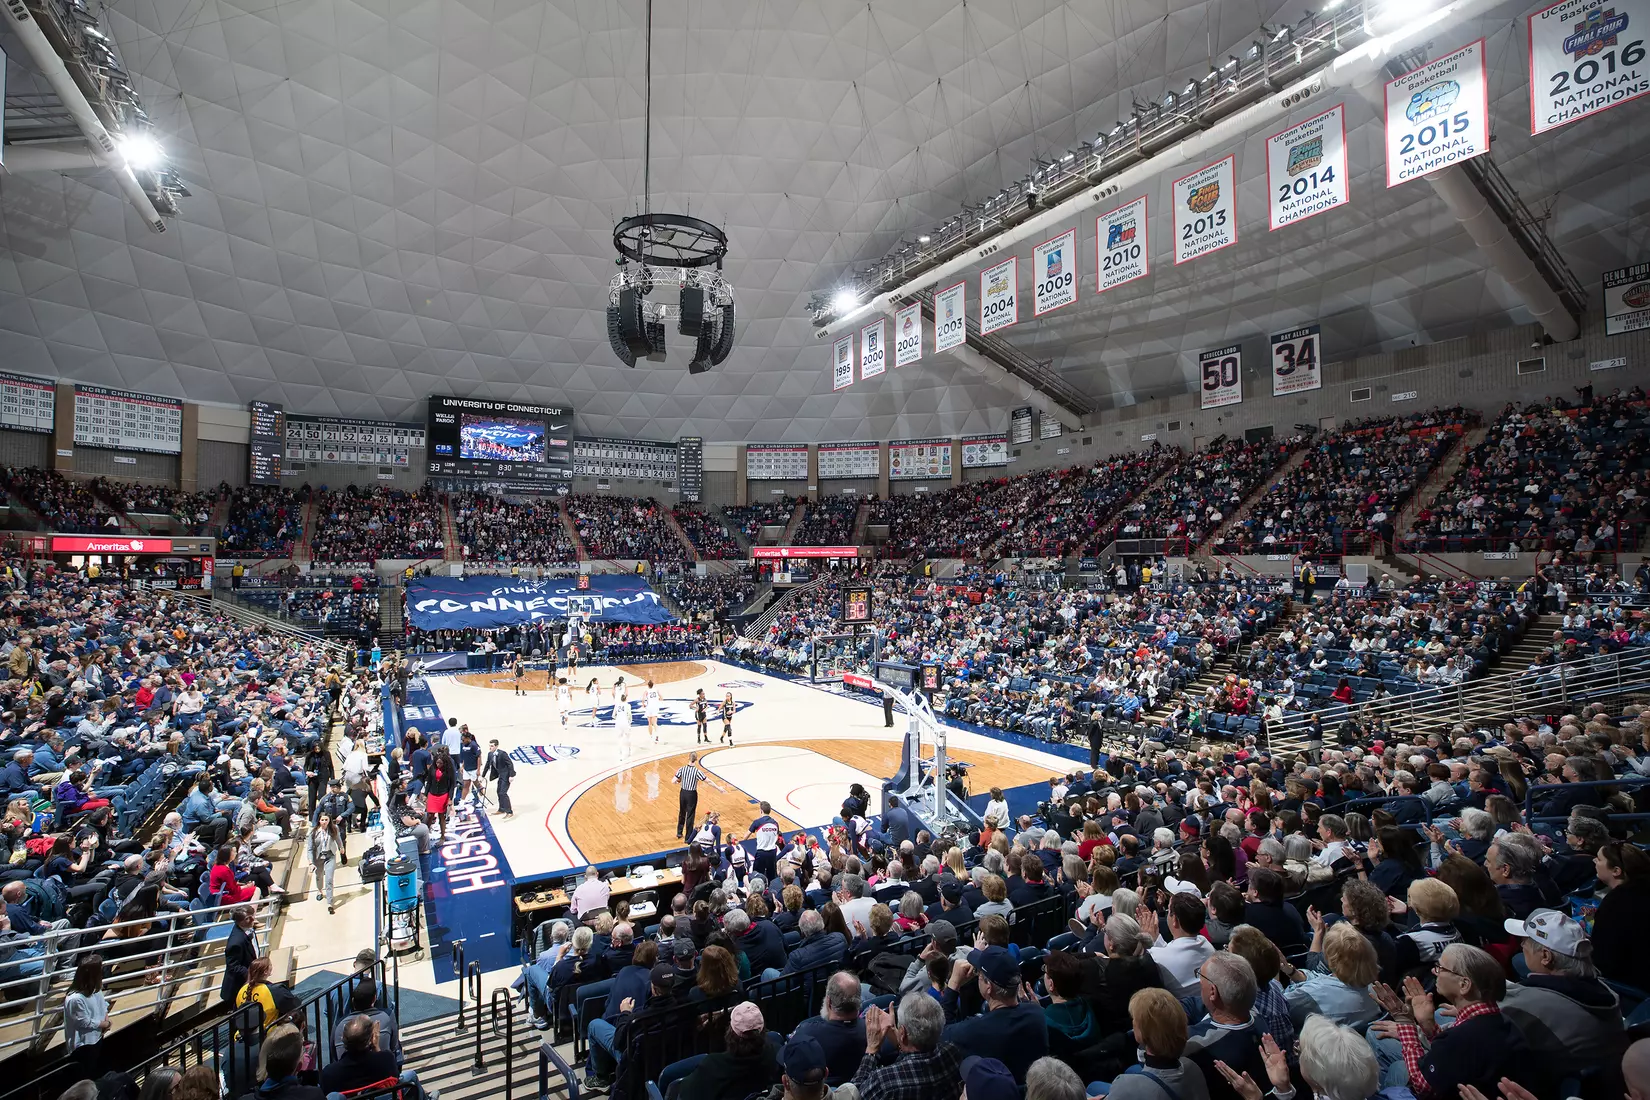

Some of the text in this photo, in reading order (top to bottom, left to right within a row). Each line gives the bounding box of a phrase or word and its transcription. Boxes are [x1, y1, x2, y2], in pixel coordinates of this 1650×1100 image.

[1542, 0, 1582, 19] UCon
[1561, 0, 1608, 22] Basket
[1568, 18, 1623, 50] FINAL FOUR
[1394, 47, 1473, 88] UConn Women's
[1550, 40, 1646, 97] 2016
[1408, 63, 1458, 91] Basketball
[1554, 70, 1641, 109] NATIONAL
[1548, 80, 1650, 124] CHAMPIONS
[1274, 111, 1335, 143] UConn Women's
[1400, 111, 1469, 155] 2015
[1285, 124, 1324, 147] Basketball
[1404, 136, 1468, 166] NATIONAL
[1399, 146, 1474, 179] CHAMPIONS
[1178, 161, 1227, 187] UConn Women's
[1188, 172, 1219, 190] Basketball
[1198, 183, 1219, 196] FINAL
[1279, 165, 1335, 203] 2014
[1190, 190, 1219, 209] FOUR
[1282, 188, 1333, 212] NATIONAL
[1108, 210, 1134, 225] Basketball
[1278, 196, 1338, 224] CHAMPIONS
[1182, 209, 1226, 240] 2013
[1184, 229, 1225, 249] NATIONAL
[1043, 242, 1064, 255] Basketball
[1182, 237, 1228, 259] CHAMPIONS
[1103, 245, 1140, 271] 2010
[1106, 262, 1139, 278] NATIONAL
[1604, 269, 1625, 283] GENO
[1038, 273, 1072, 297] 2009
[1103, 269, 1142, 288] CHAMPIONS
[1039, 296, 1072, 312] CHAMPIONS
[1041, 289, 1069, 304] NATIONAL
[984, 296, 1014, 318] 2004
[985, 318, 1013, 332] CHAMPIONS
[987, 311, 1011, 324] NATIONAL
[938, 318, 962, 337] 2003
[1292, 329, 1310, 338] ALLEN
[898, 335, 919, 352] 2002
[939, 338, 962, 350] CHAMPIONS
[940, 333, 961, 343] NATIONAL
[863, 350, 884, 366] 2000
[898, 354, 919, 364] CHAMPIONS
[900, 348, 917, 357] NATIONAL
[1203, 347, 1237, 360] REBECCA LOBO
[1276, 337, 1316, 376] 34
[836, 364, 851, 377] 1995
[1610, 358, 1626, 367] 211
[1203, 356, 1238, 391] 50
[1296, 380, 1319, 388] RETIRED
[81, 392, 177, 409] TOURNAMENT APPEARANCES
[82, 386, 177, 404] NCAA CHAMPIONSHIP
[1203, 397, 1220, 405] NUMBER
[76, 406, 88, 414] 1996
[93, 408, 105, 416] 1997
[125, 412, 136, 420] 1999
[140, 414, 151, 422] 2000
[125, 403, 136, 411] 1992
[443, 399, 493, 409] UNIVERSITY
[507, 405, 562, 416] CONNECTICUT
[76, 415, 88, 423] 2003
[92, 417, 105, 425] 2004
[92, 426, 105, 434] 2011
[108, 428, 120, 436] 2012
[288, 430, 301, 438] 24
[307, 431, 319, 439] 50
[326, 432, 337, 440] 21
[344, 433, 354, 441] 52
[430, 464, 440, 472] 33
[498, 464, 512, 472] 8:30
[564, 470, 572, 478] 20
[87, 542, 130, 551] Ameritas
[178, 577, 201, 585] Coke
[578, 580, 588, 589] 30
[851, 592, 867, 603] 8:30
[849, 603, 865, 620] 30
[441, 804, 506, 895] HUSKIES
[242, 990, 260, 1002] CC
